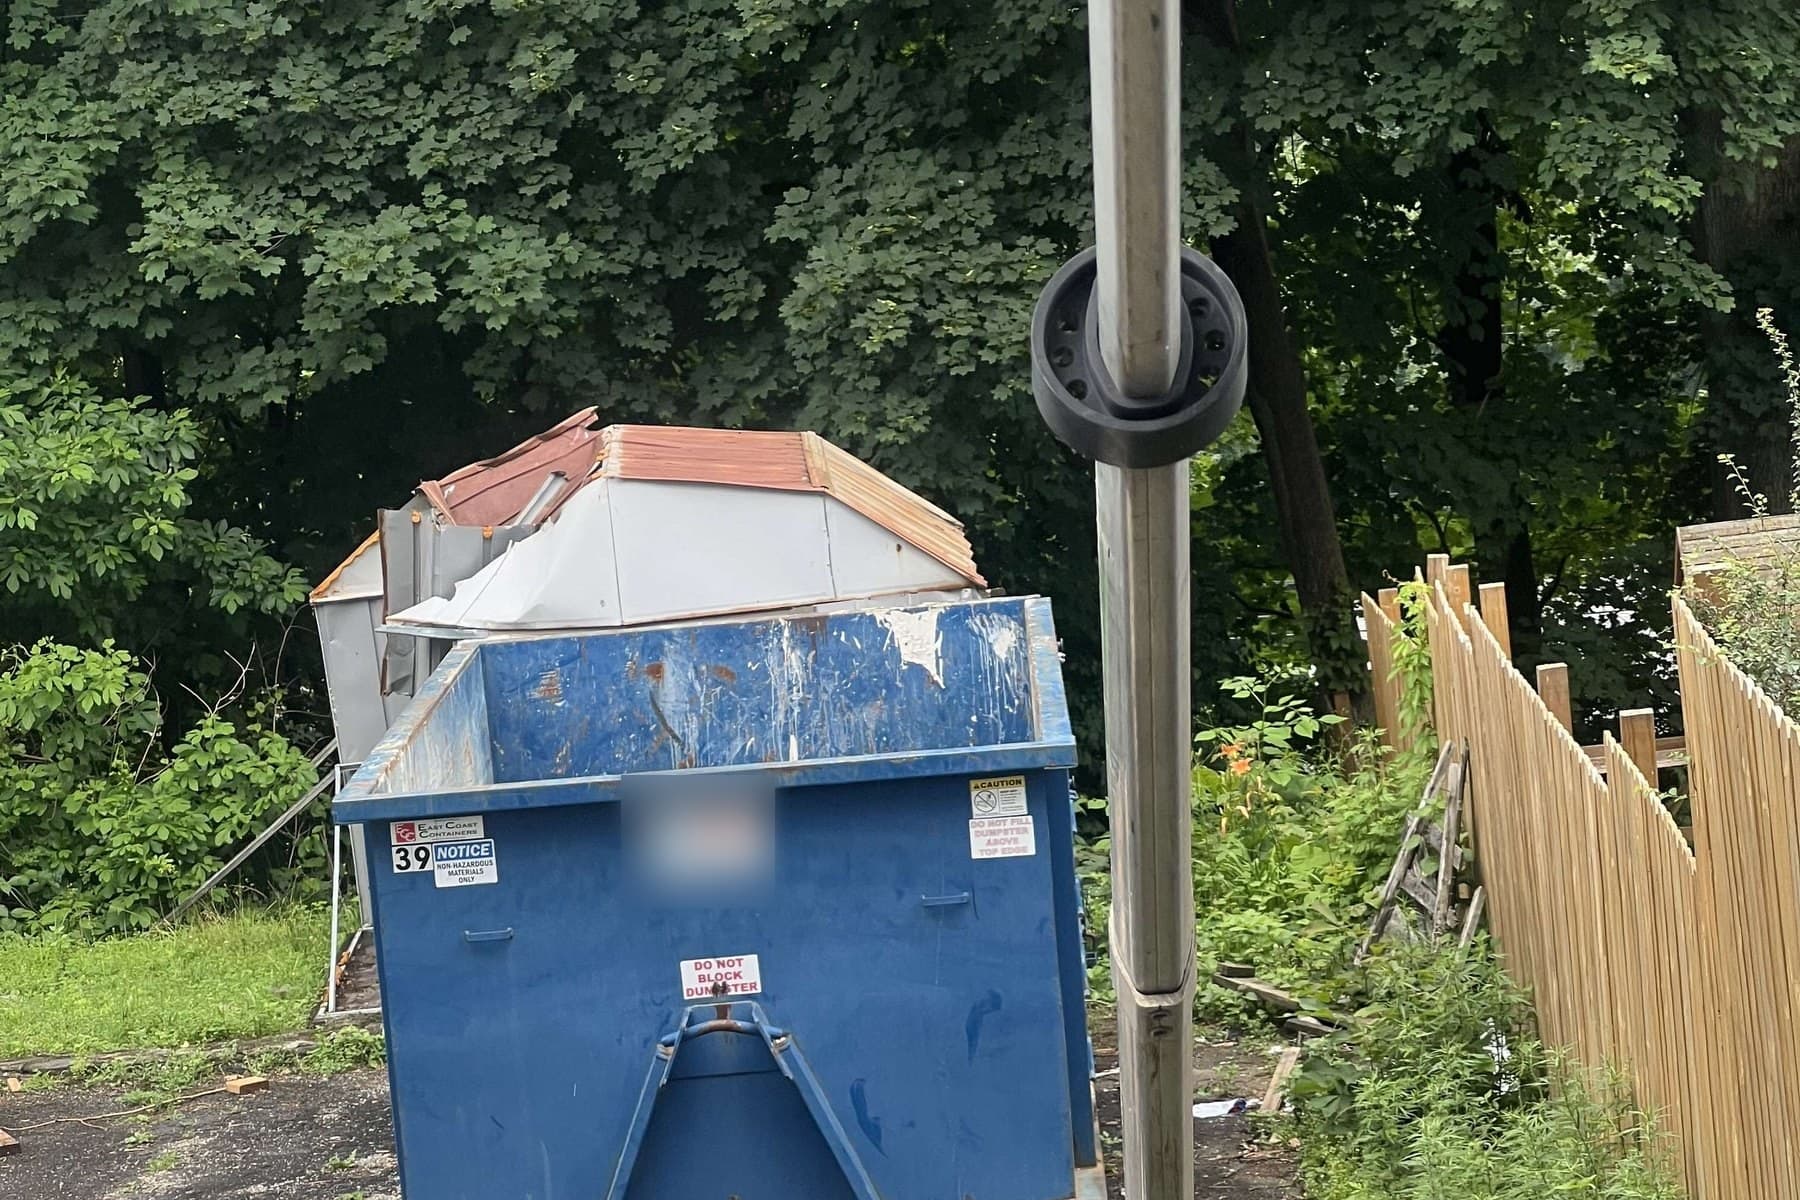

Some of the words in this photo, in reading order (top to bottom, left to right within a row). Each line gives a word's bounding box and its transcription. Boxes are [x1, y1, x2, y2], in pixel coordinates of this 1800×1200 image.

[980, 779, 1022, 789] CAUTION
[418, 824, 443, 832] EAST
[445, 821, 478, 830] COAST
[987, 819, 1008, 827] NOT
[1011, 818, 1030, 826] FILL
[419, 830, 478, 838] CONTAINERS
[974, 827, 1029, 837] DUMPSTER
[986, 837, 1019, 846] ABOVE
[437, 843, 491, 859] NOTICE
[979, 848, 998, 856] TOP
[1001, 846, 1028, 855] EDGE
[395, 846, 431, 871] 39
[437, 860, 494, 870] NON-HAZARDOUS
[447, 869, 484, 877] MATERIALS
[694, 960, 712, 970] DO
[717, 958, 744, 969] NOT
[698, 970, 743, 983] BLOCK
